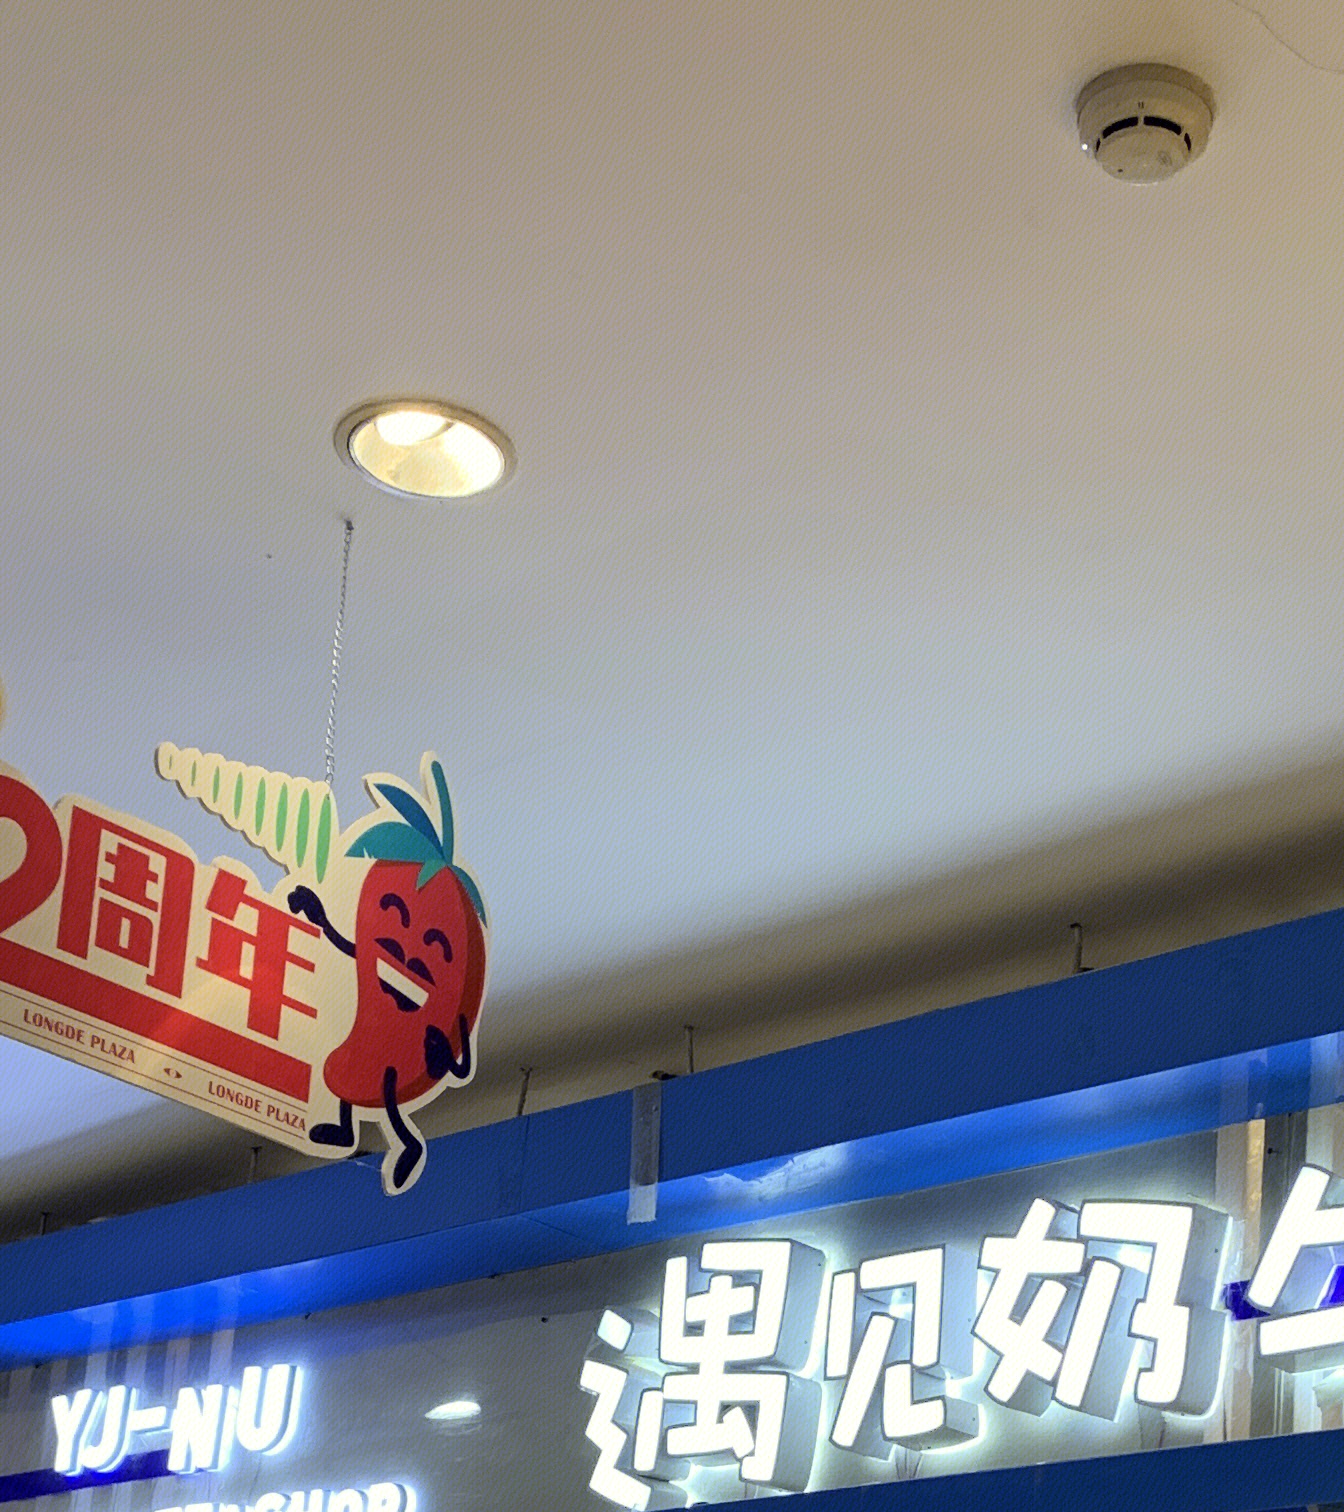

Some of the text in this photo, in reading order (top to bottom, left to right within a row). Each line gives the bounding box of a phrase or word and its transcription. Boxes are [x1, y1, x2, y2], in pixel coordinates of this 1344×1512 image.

[22, 1008, 86, 1046] LONGDE
[90, 1028, 138, 1064] PLAZA
[207, 1079, 263, 1112] LONGDE
[266, 1099, 308, 1132] PLAZA
